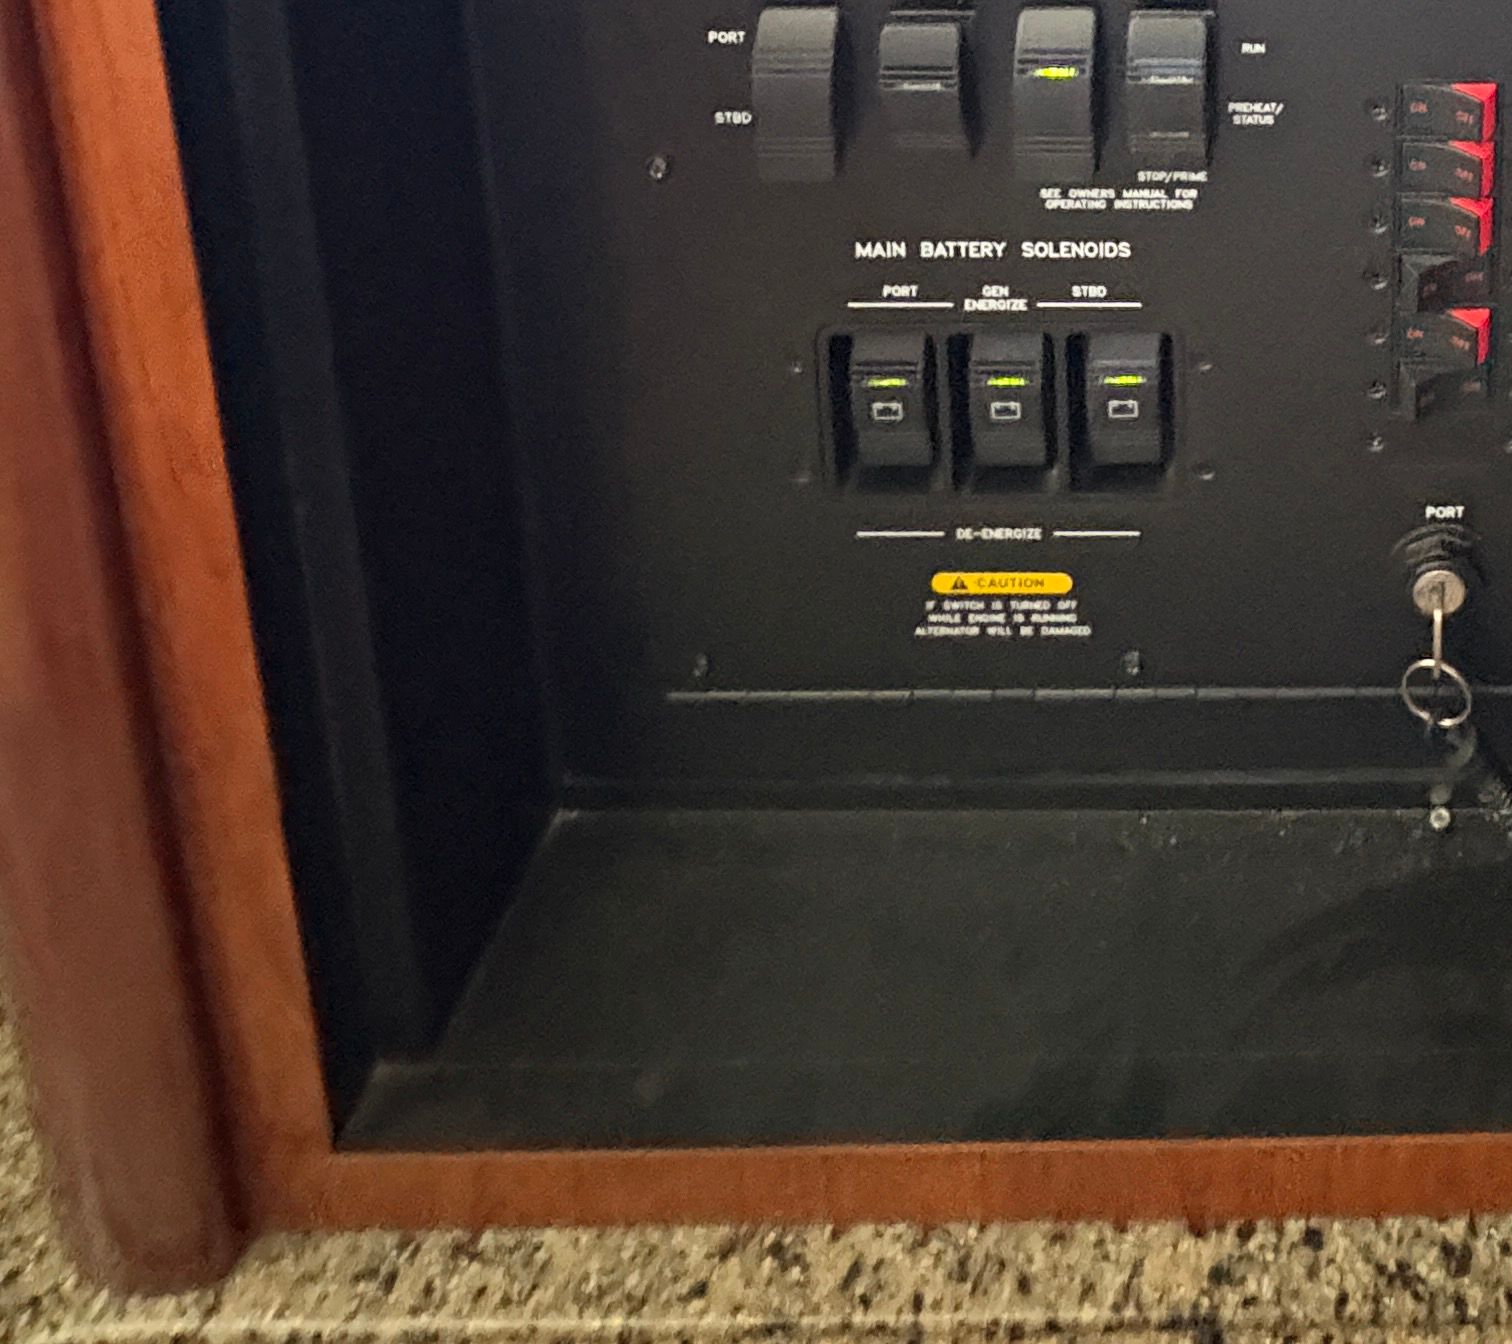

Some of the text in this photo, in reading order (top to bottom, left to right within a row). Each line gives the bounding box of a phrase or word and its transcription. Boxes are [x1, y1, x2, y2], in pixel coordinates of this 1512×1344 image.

[708, 31, 746, 43] PORT
[1241, 43, 1266, 53] RUN
[714, 112, 752, 124] STBD
[1233, 115, 1274, 125] STATUS
[1138, 171, 1208, 182] STOP/PRIME
[856, 241, 1131, 258] MAIN BATTERY SOLENOIDS
[883, 286, 918, 297] PORT
[983, 286, 1009, 297] GEN
[1072, 286, 1106, 297] STBD
[964, 299, 1028, 311] ENERGIZE
[1425, 506, 1464, 519] PORT
[956, 528, 1041, 540] DE-ENERGIZE
[977, 578, 1044, 588] CAUTION
